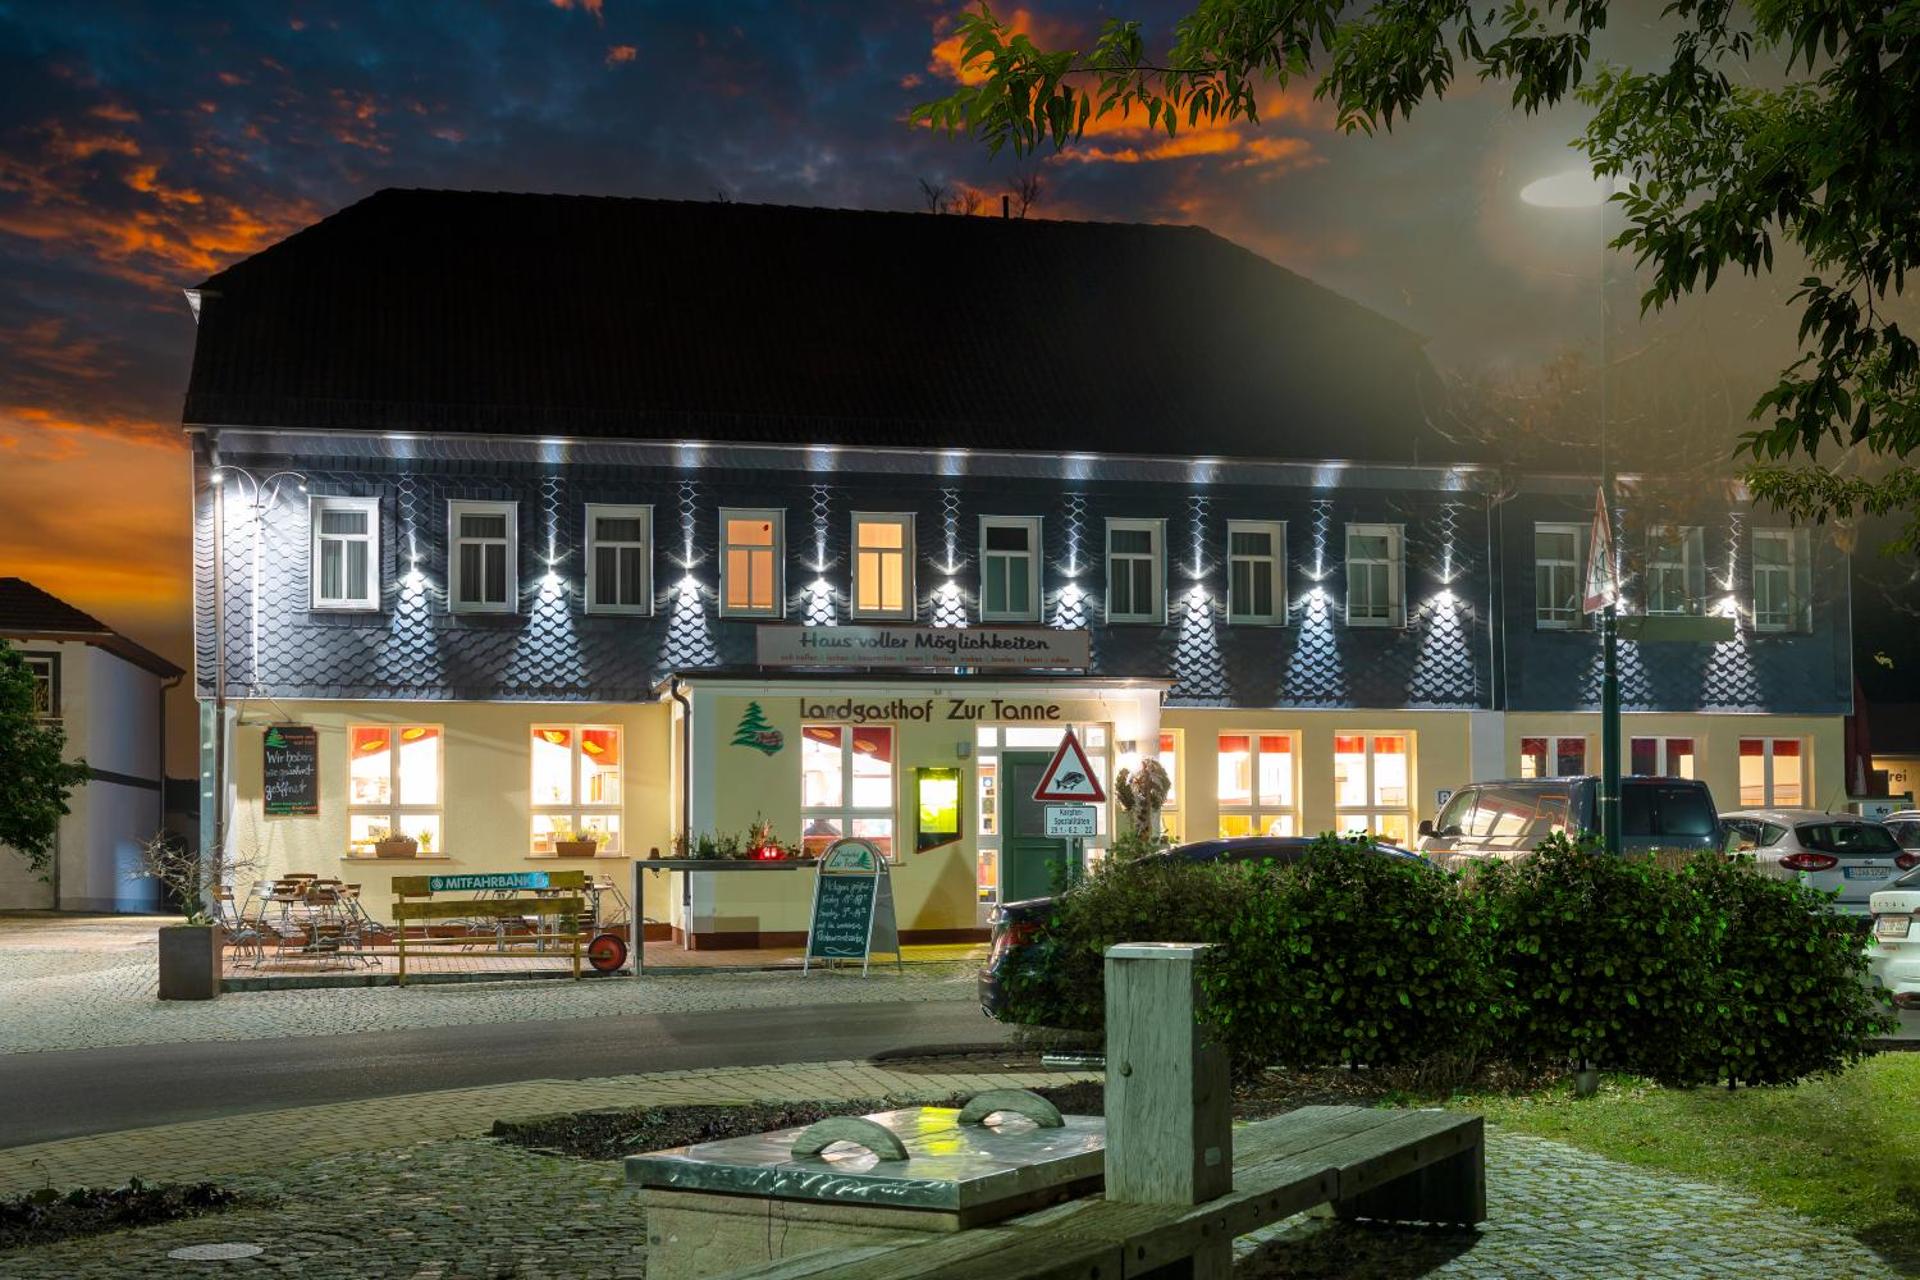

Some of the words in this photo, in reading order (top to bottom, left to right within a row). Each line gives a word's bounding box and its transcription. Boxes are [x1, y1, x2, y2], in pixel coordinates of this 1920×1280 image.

[798, 632, 853, 648] Haus
[858, 632, 909, 648] voller
[915, 632, 1050, 654] Möglichkeiten
[800, 698, 933, 723] Landgasthof
[947, 699, 985, 720] Zur
[992, 699, 1060, 720] Tanne
[266, 751, 284, 764] Wir
[445, 876, 530, 889] MITFAHRBANK
